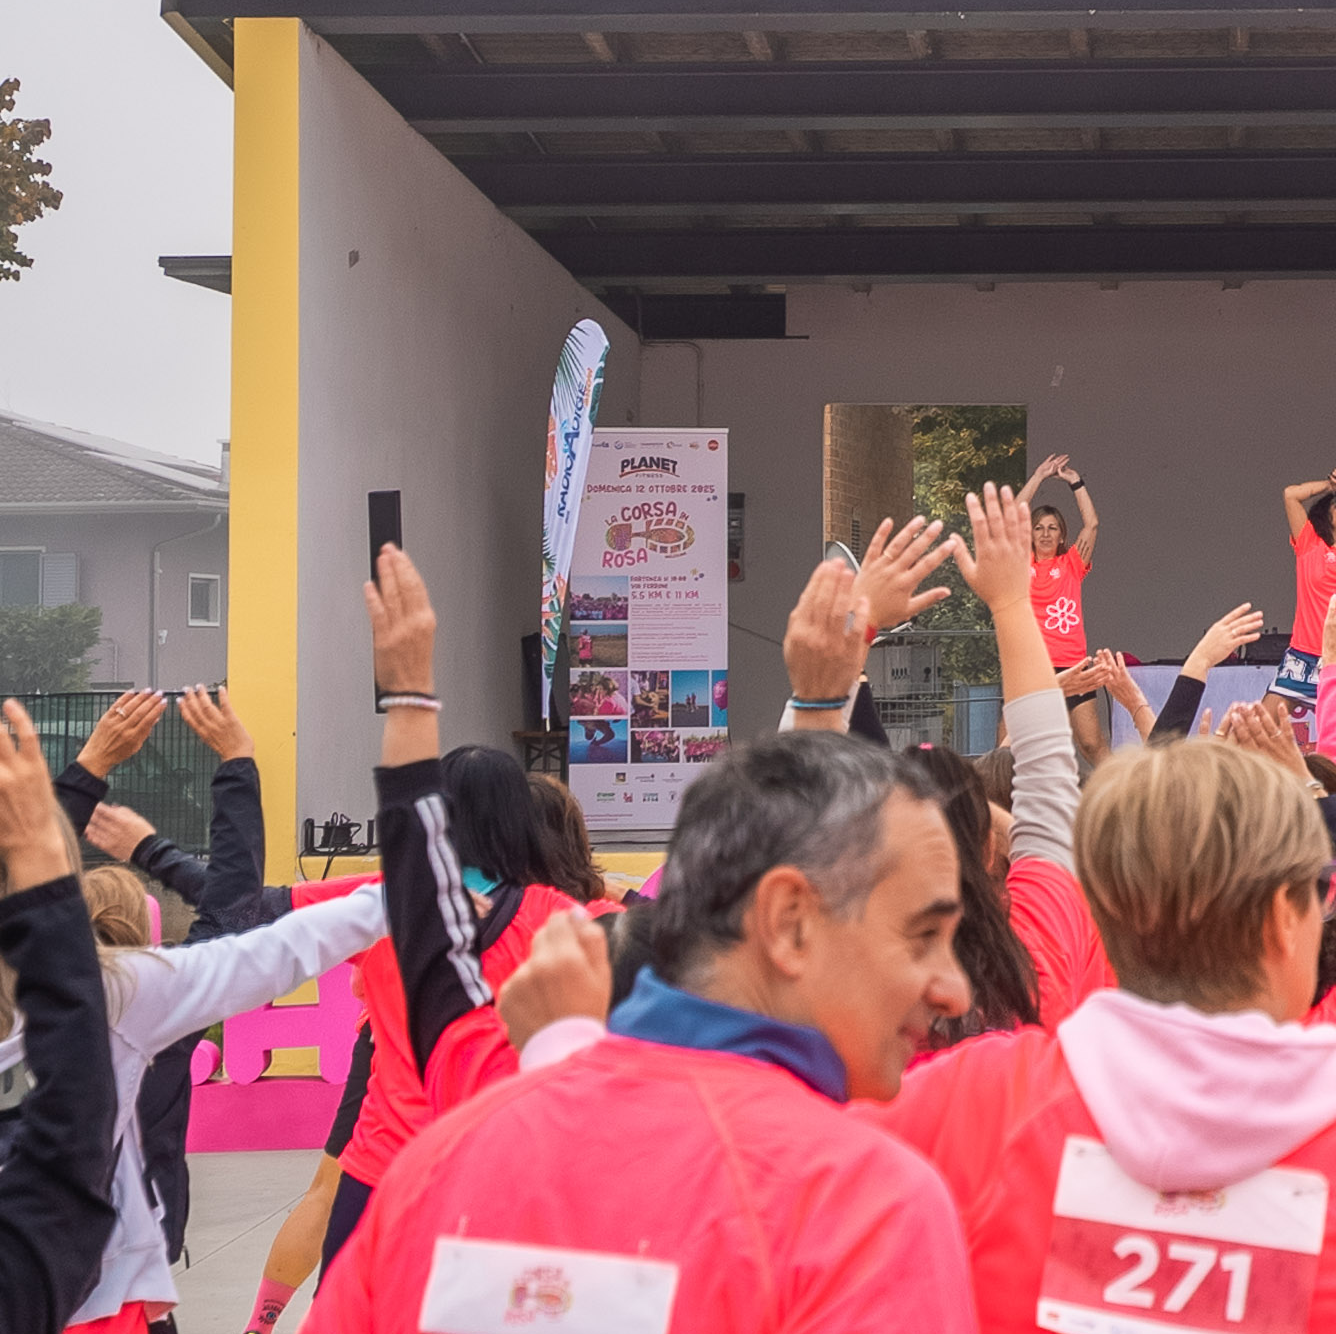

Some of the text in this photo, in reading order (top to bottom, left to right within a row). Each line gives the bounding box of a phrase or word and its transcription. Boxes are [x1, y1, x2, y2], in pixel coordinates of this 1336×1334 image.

[621, 456, 678, 474] PLANET
[587, 484, 715, 493] DOMENICA 12 OTTOBRE 2025
[605, 515, 618, 526] LA
[621, 501, 678, 522] CORSA
[602, 547, 648, 568] ROSA
[1103, 1234, 1253, 1324] 271
